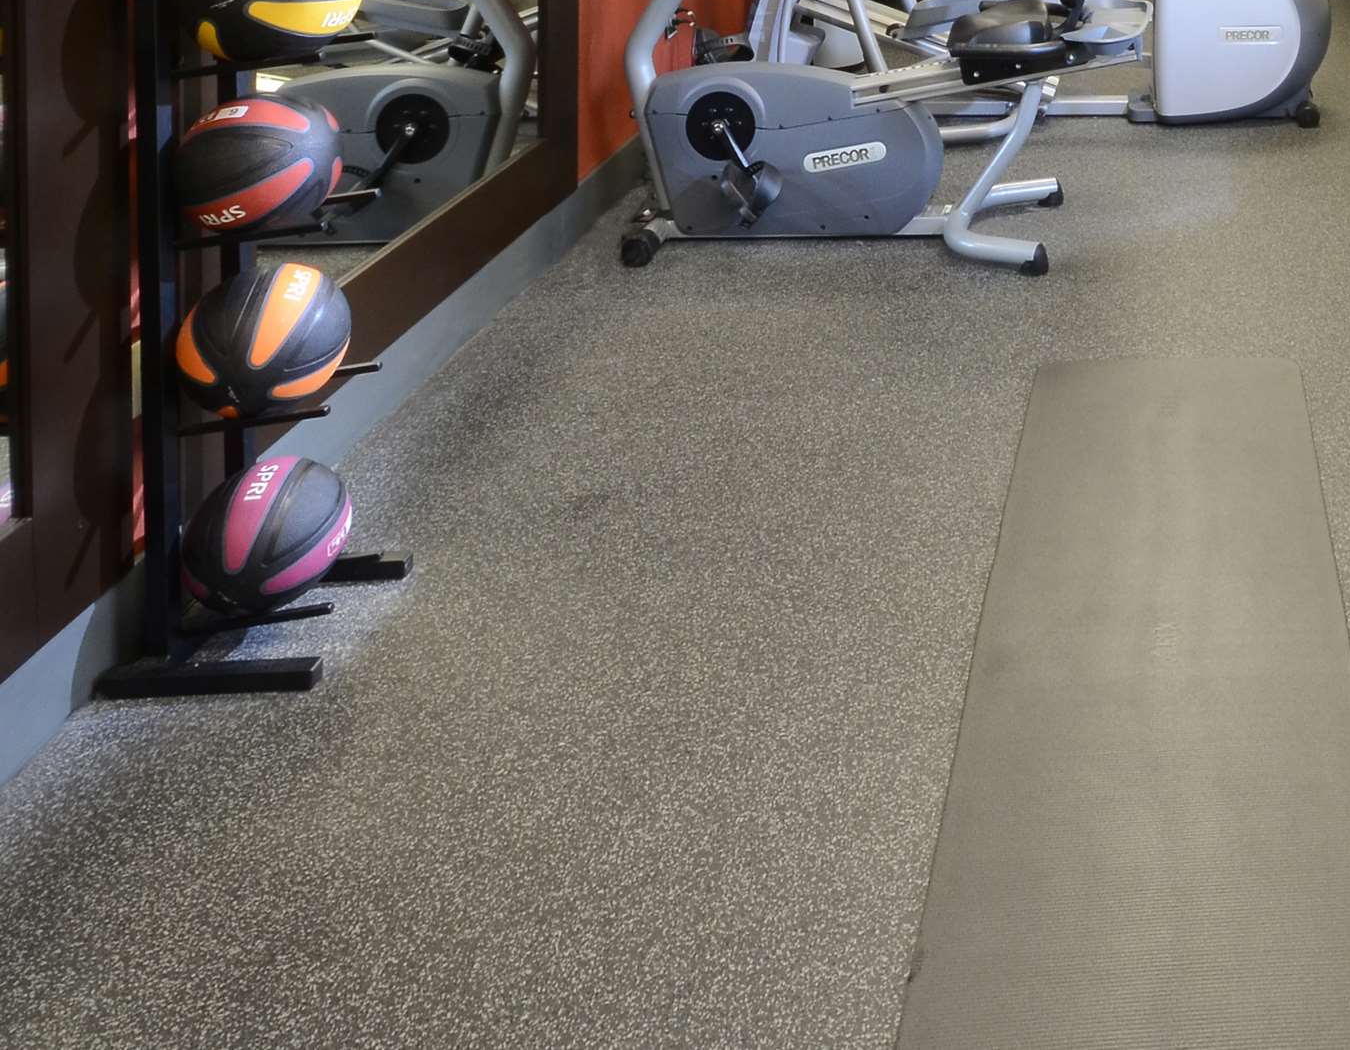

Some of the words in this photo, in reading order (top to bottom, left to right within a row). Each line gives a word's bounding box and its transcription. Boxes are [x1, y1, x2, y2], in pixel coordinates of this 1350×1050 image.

[1225, 30, 1270, 40] PRECOR
[812, 148, 870, 169] PRECOR
[200, 205, 247, 226] SPRI
[283, 269, 312, 302] SPRI
[244, 464, 279, 501] SPRI
